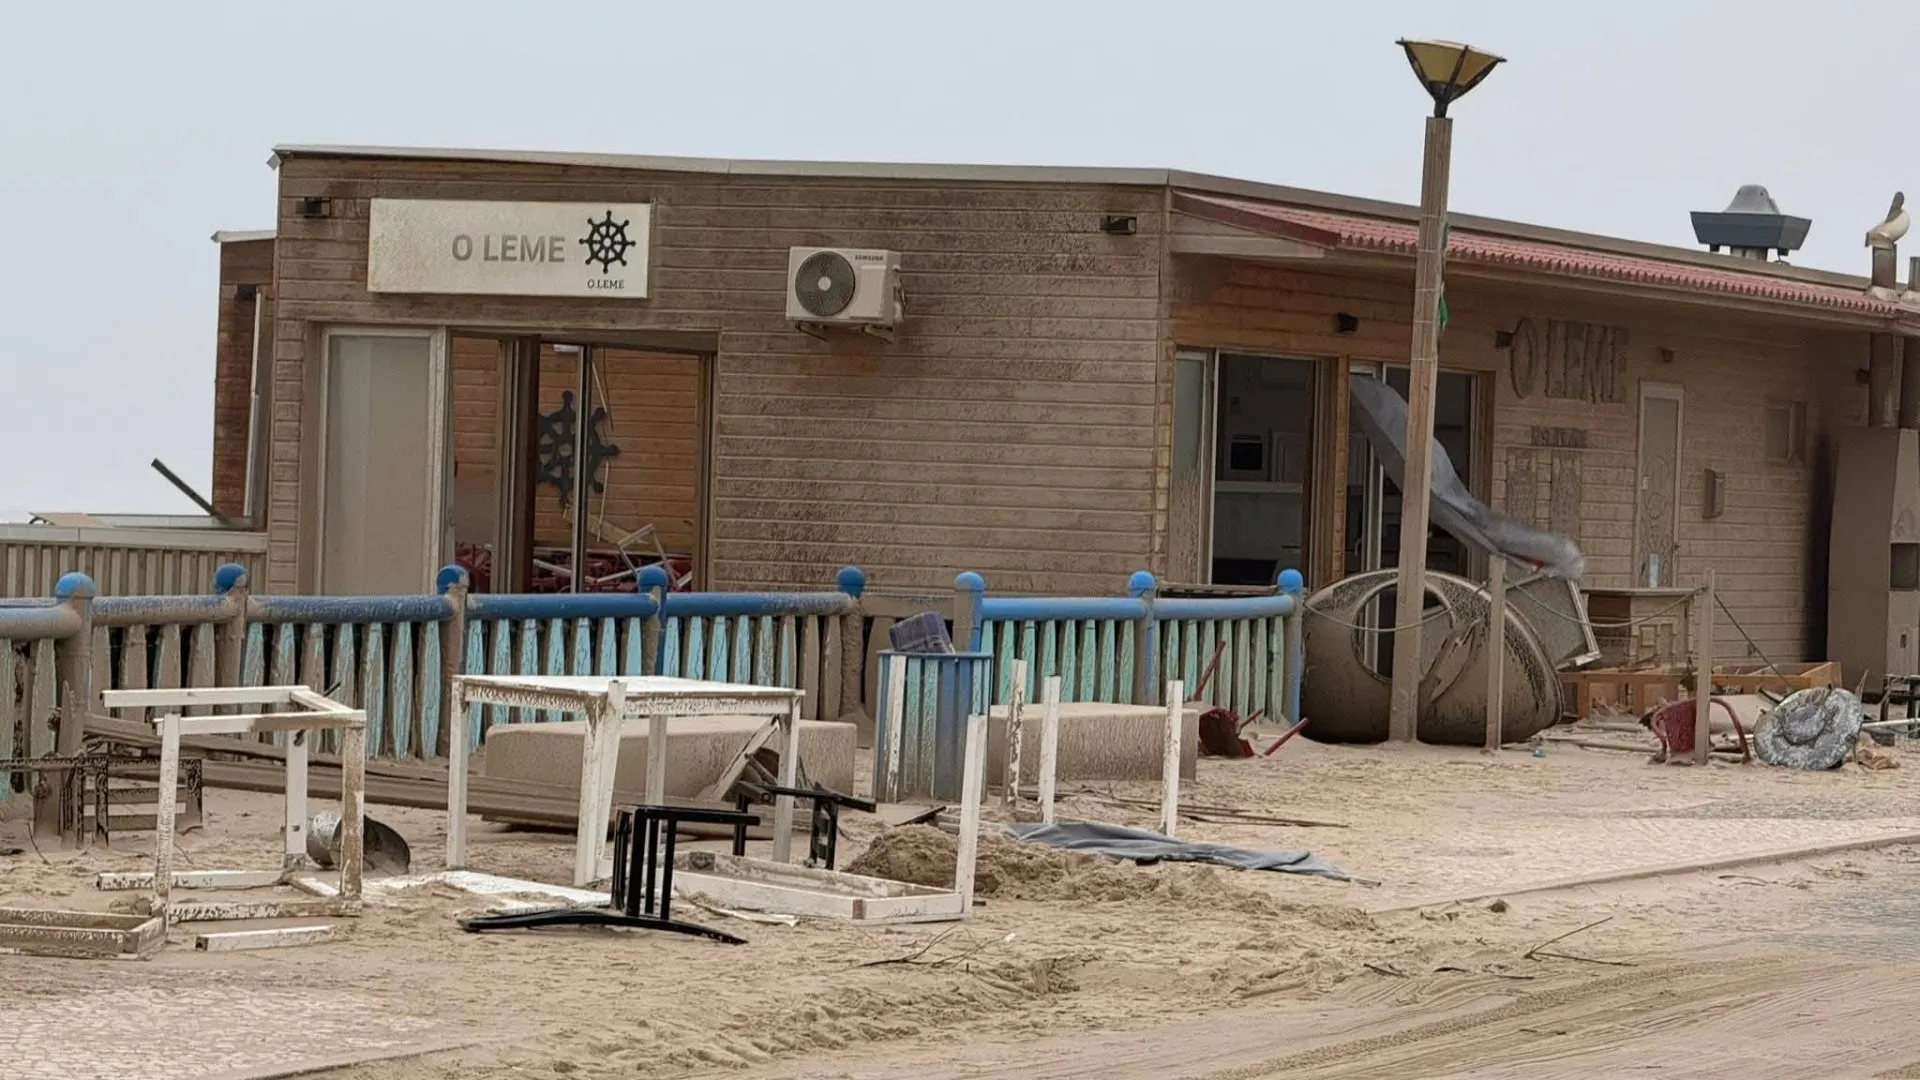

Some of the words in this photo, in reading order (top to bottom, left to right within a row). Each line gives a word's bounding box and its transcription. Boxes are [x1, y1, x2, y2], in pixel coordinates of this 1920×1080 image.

[451, 234, 473, 262] O
[483, 234, 566, 263] LEME
[587, 278, 595, 290] O
[597, 278, 625, 290] LEME
